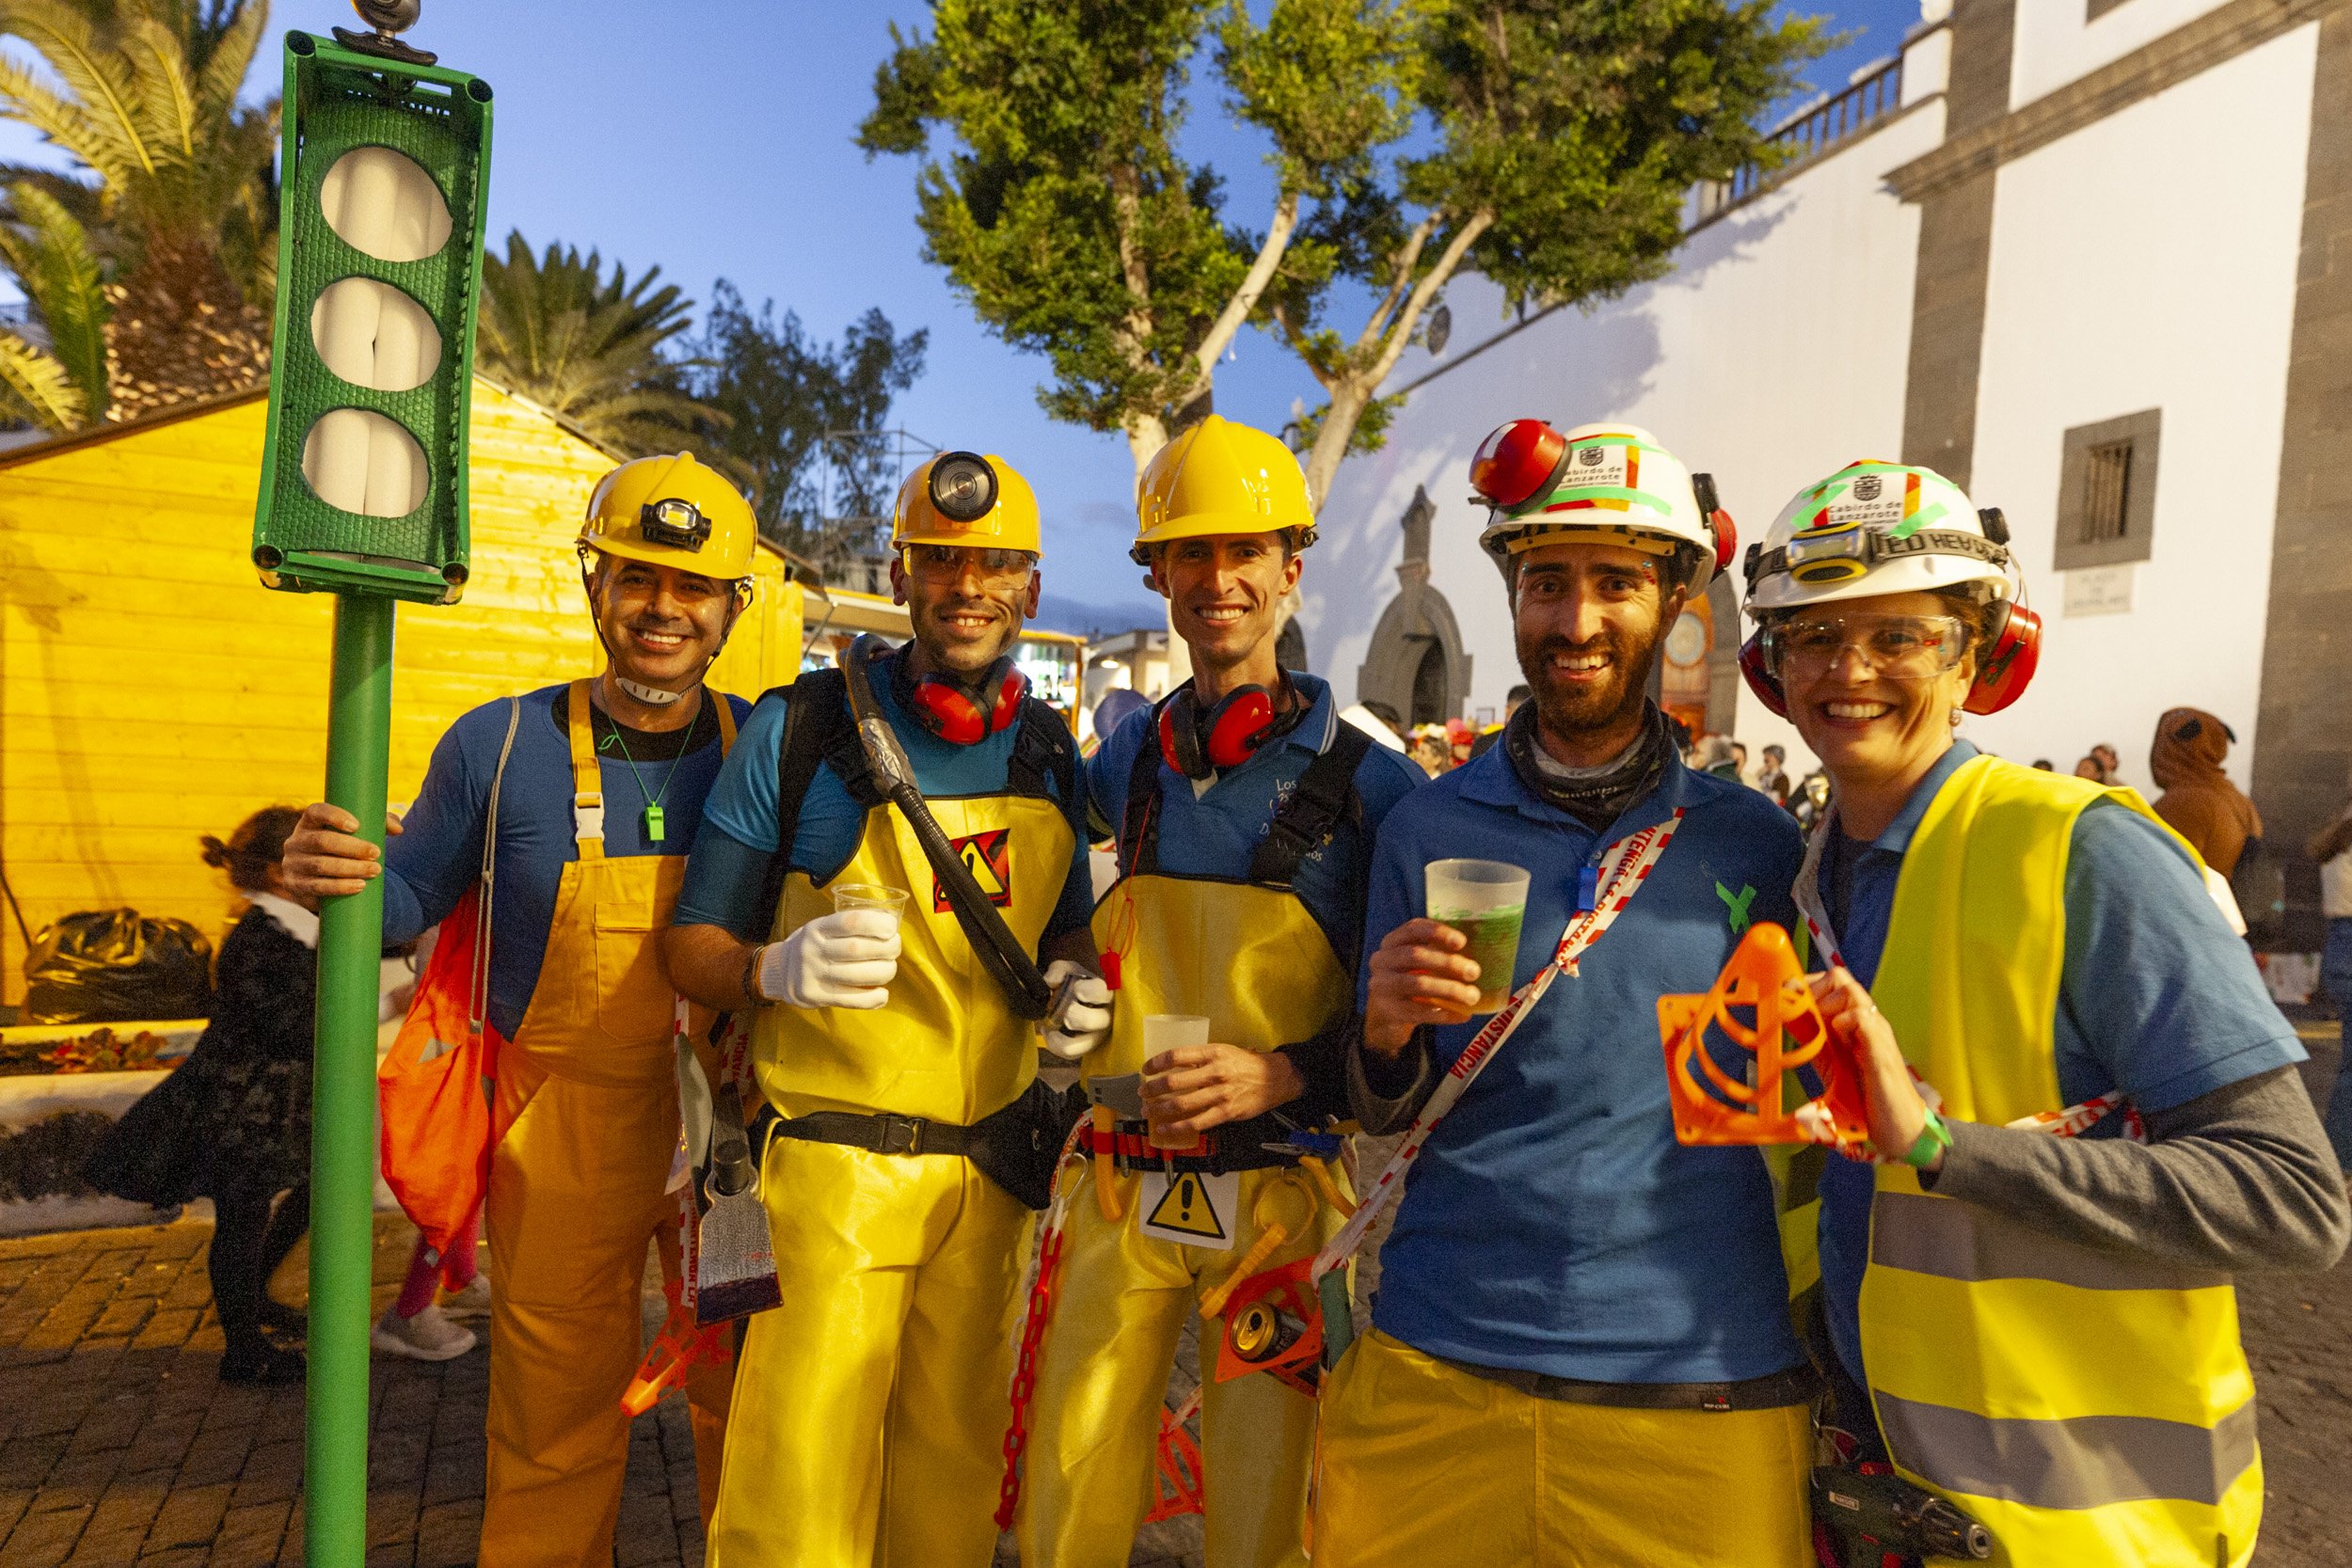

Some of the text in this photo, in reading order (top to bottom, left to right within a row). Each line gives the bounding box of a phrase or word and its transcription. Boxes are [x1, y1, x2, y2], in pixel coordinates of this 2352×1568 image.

[1565, 466, 1604, 475] abirdo
[1561, 473, 1620, 483] anzarote
[1829, 500, 1902, 513] Cabirdo de
[1830, 510, 1899, 521] Lanzarote
[1276, 778, 1297, 791] Los
